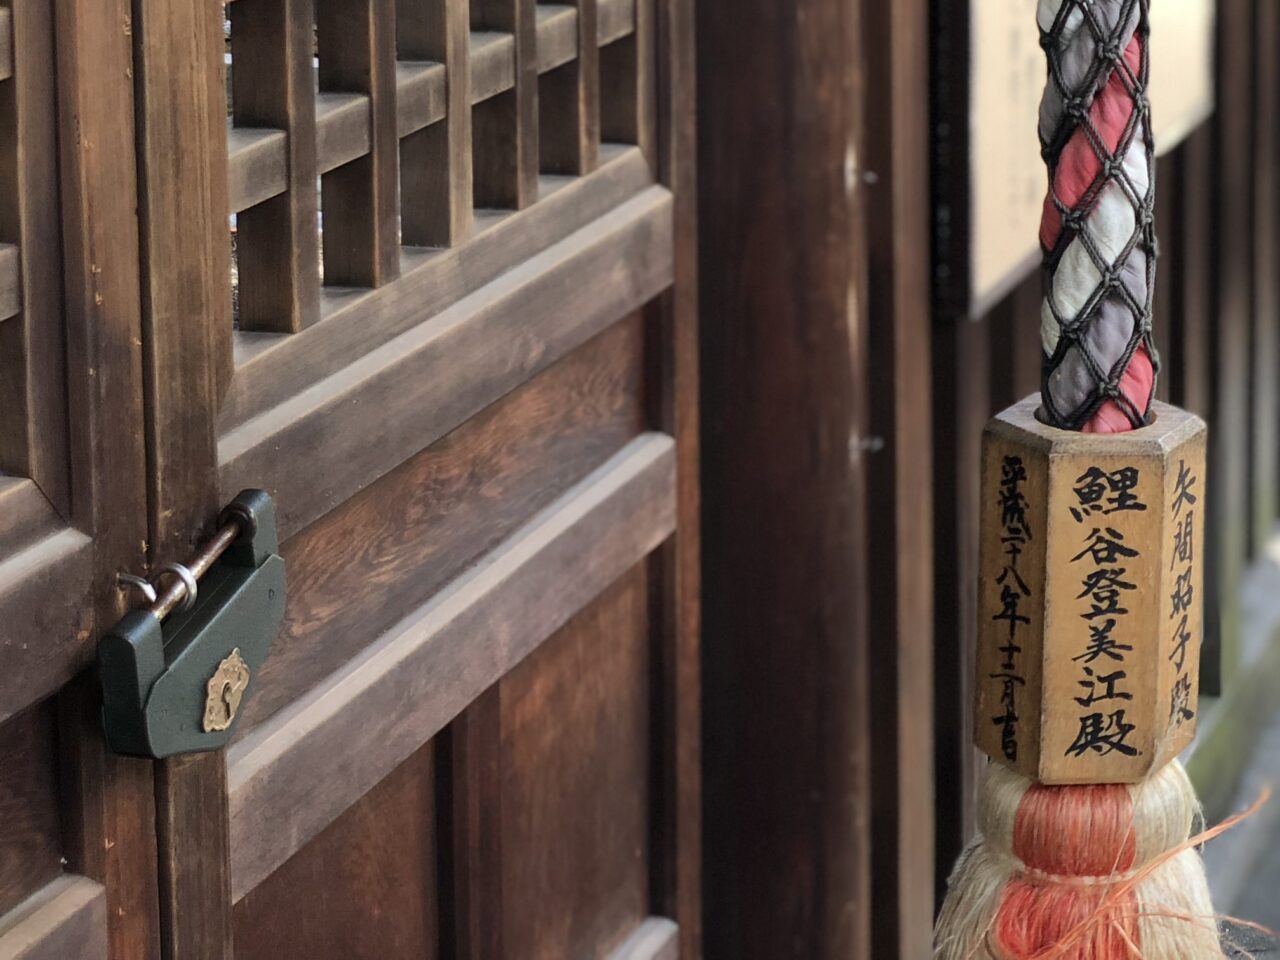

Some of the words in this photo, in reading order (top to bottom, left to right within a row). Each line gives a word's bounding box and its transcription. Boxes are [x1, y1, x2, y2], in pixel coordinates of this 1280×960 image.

[1065, 466, 1147, 757] 鯉谷登美江殿
